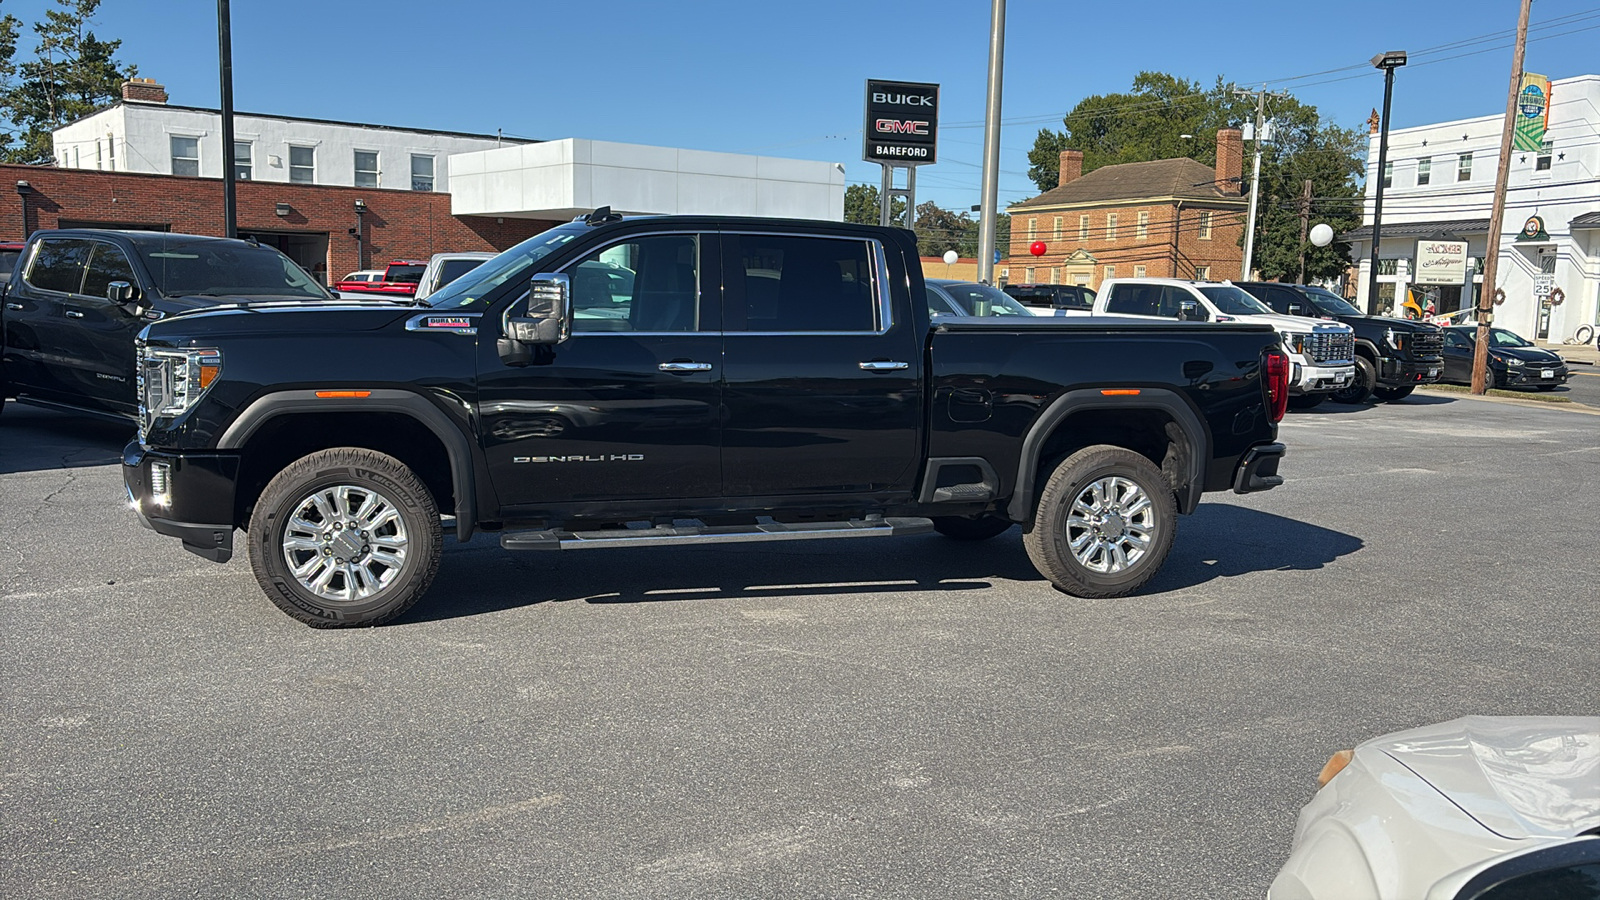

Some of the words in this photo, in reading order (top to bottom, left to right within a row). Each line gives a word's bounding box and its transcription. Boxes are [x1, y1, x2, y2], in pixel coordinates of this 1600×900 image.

[873, 93, 933, 106] BUICK
[876, 118, 929, 135] GMC
[876, 145, 927, 157] BAREFORD
[1535, 285, 1550, 294] 25
[513, 455, 605, 463] DENALI
[371, 474, 415, 507] MICHELIN
[277, 583, 321, 615] MICHELIN
